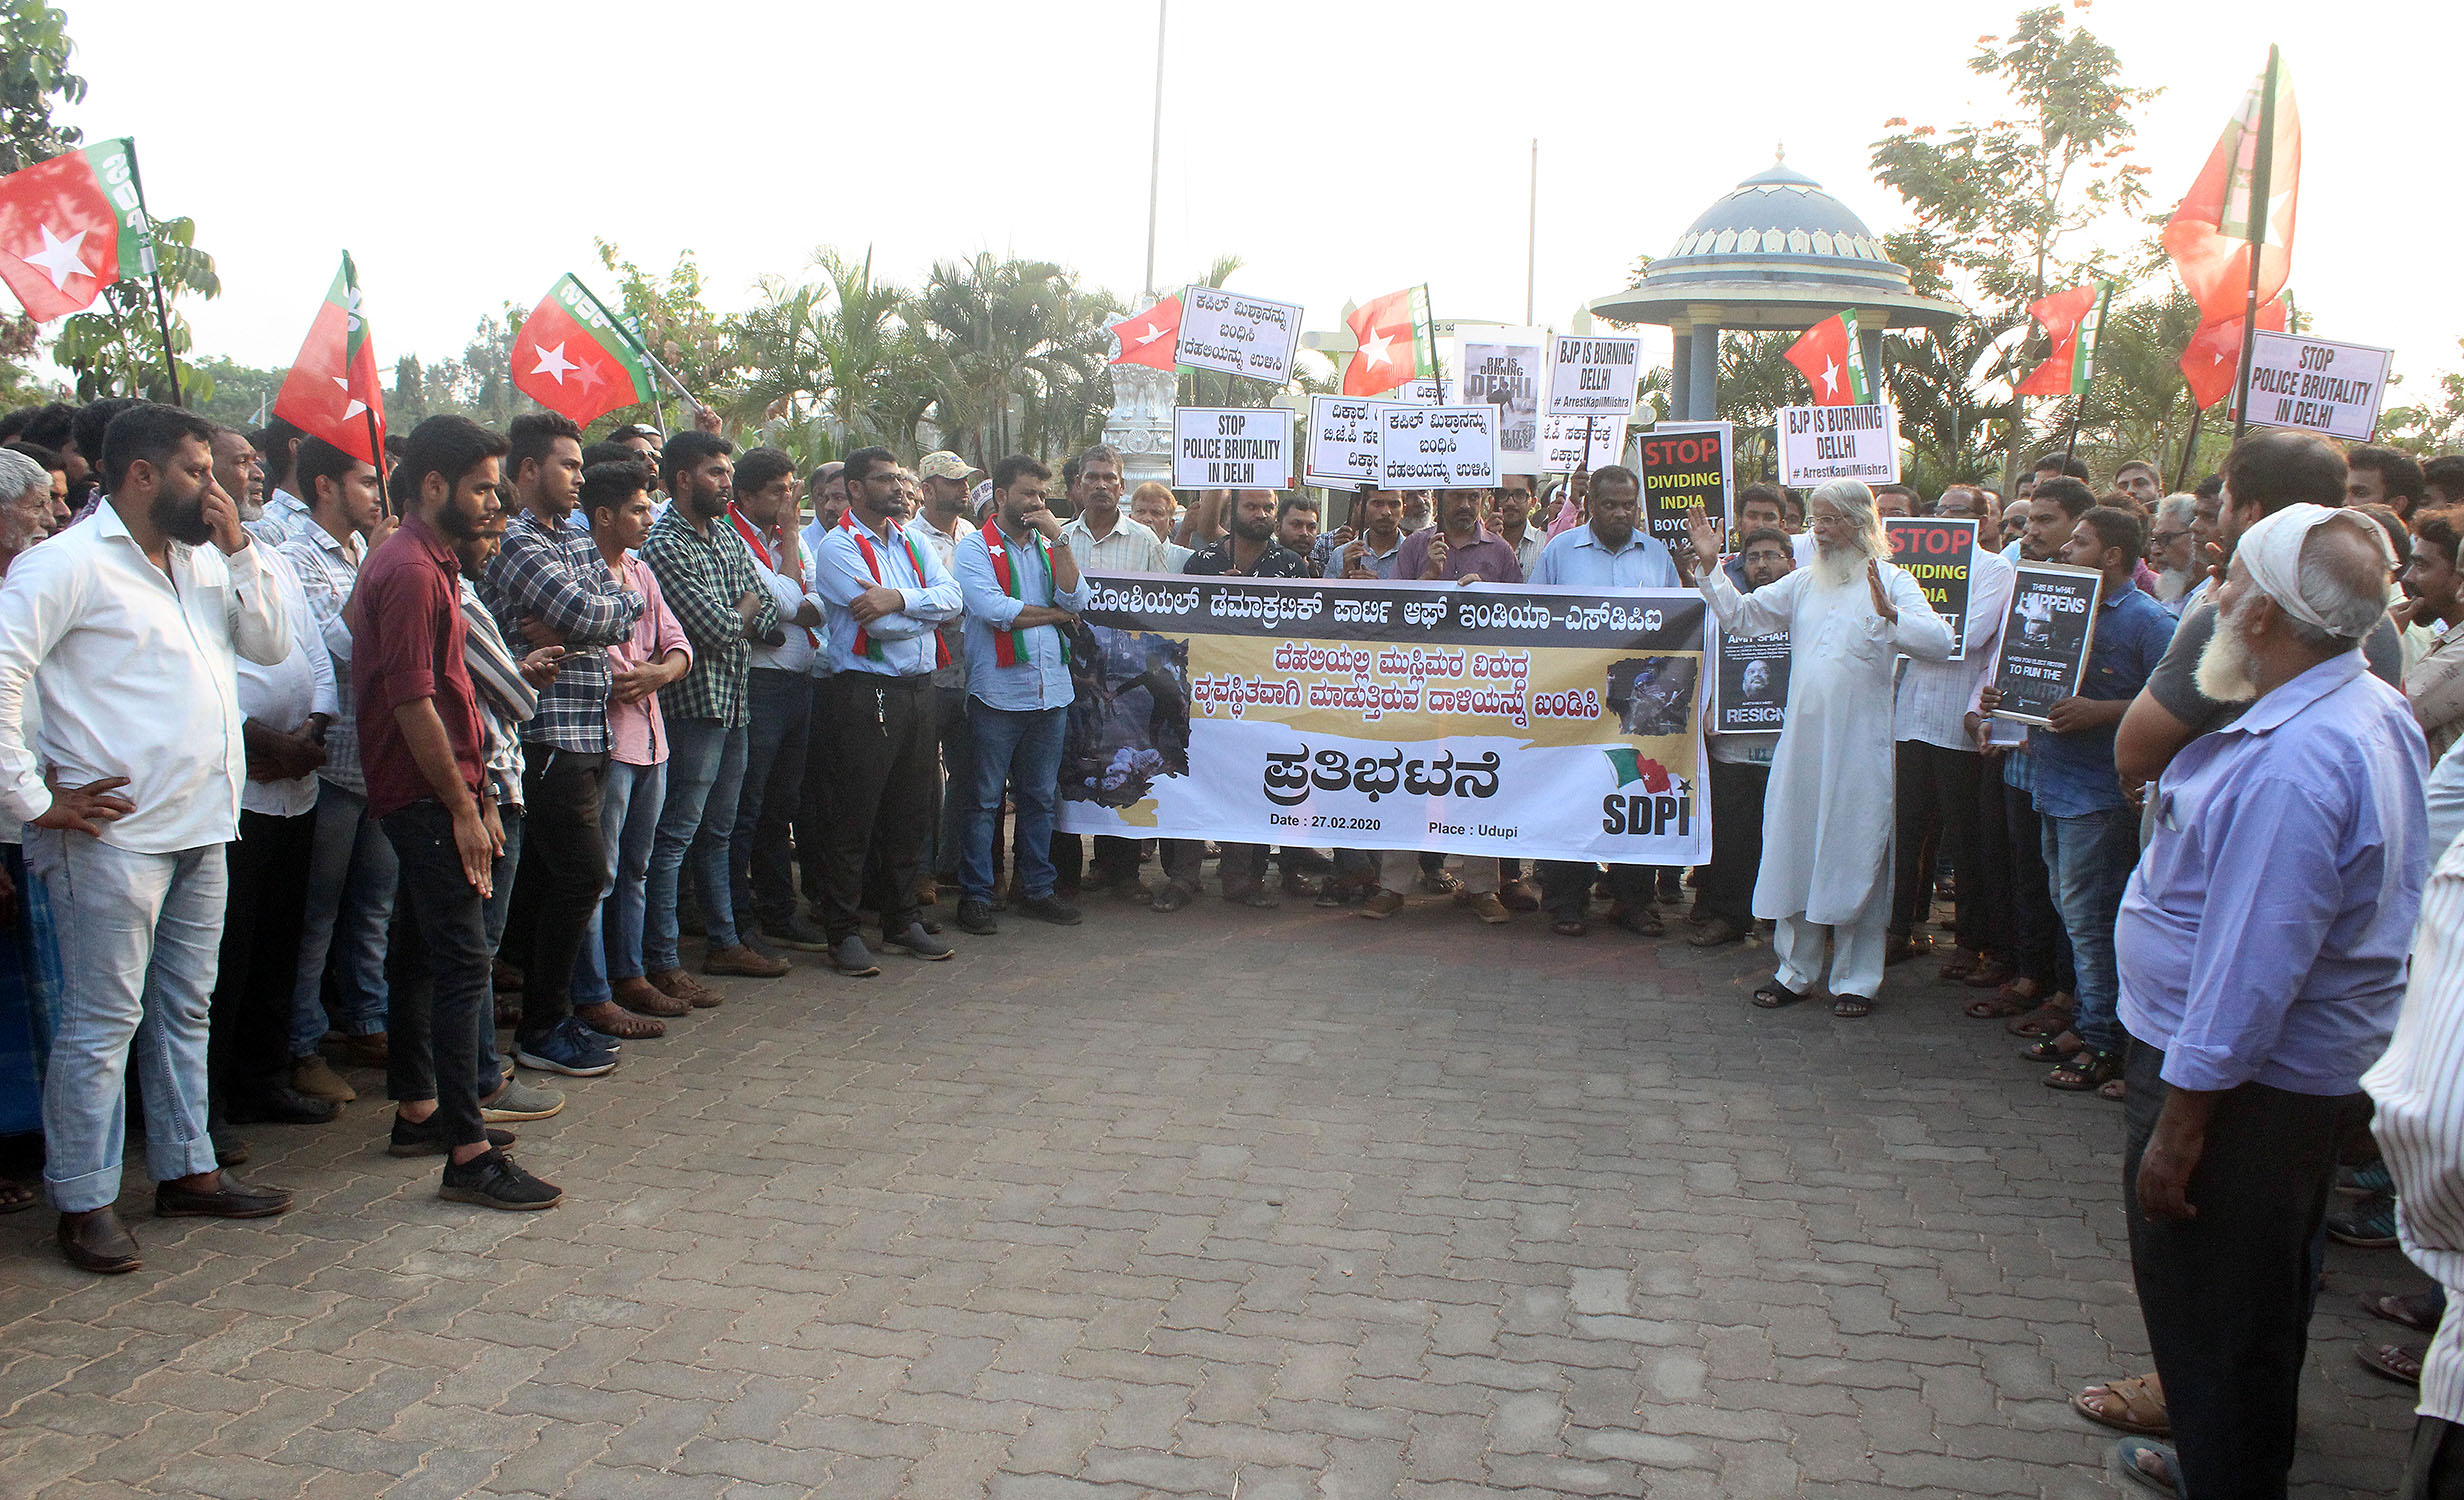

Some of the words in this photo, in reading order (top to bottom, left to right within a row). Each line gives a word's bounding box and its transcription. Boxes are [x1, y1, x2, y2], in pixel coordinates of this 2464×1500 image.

[1196, 294, 1230, 312] ಕಪಿಲ್
[1220, 323, 1255, 342] ಬಂಧಿಸಿ
[1184, 337, 1243, 371] ದೆಹಲಿಯನ್ನು
[1250, 353, 1282, 371] ಉಳಿಸಿ
[1487, 357, 1504, 367] BJP
[1508, 357, 1518, 367] IS
[1560, 341, 1580, 364] BJP
[1582, 342, 1592, 364] IS
[1594, 342, 1635, 365] BURNING
[2299, 346, 2335, 372] STOP
[1480, 366, 1524, 377] BURNING
[1580, 368, 1611, 390] DELLHI
[2251, 367, 2300, 396] POLICE
[2300, 373, 2372, 406] BRUTALITY
[1218, 415, 1246, 435] STOP
[1389, 411, 1424, 430] ಕಪಿಲ್
[1430, 412, 1487, 435] ಮಿಶ್ರಾನನ್ನು
[1790, 410, 1810, 434] BJP
[1814, 409, 1825, 433] IS
[1828, 405, 1883, 433] BURNING
[2274, 398, 2293, 423] IN
[2293, 401, 2334, 429] DELHI
[1183, 438, 1221, 459] POLICE
[1224, 439, 1280, 460] BRUTALITY
[1419, 438, 1457, 455] ಬಂಧಿಸಿ
[1645, 438, 1720, 466] STOP
[1816, 435, 1857, 460] DELLHI
[1208, 462, 1220, 483] IN
[1224, 463, 1254, 483] DELHI
[1387, 460, 1451, 484] ದೆಹಲಿಯನ್ನು
[1456, 462, 1491, 477] ಉಳಿಸಿ
[1647, 472, 1721, 489] DIVIDING
[1660, 494, 1705, 510] INDIA
[1654, 516, 1718, 532] BOYCT
[1888, 527, 1972, 554] STOP
[2055, 585, 2076, 595] WHAT
[1210, 587, 1323, 629] ಡೆಮಾಕ್ರಟಿಕ್
[1333, 598, 1392, 624] ಪಾರ್ಟಿ
[1403, 596, 1448, 631] ಆಫ್
[1274, 642, 1371, 685] ದೆಹಲಿಯಲ್ಲಿ
[1379, 647, 1464, 687] ಮುಸ್ಲಿಮರ
[2009, 664, 2022, 675] TO
[2022, 666, 2042, 678] RUN
[2043, 668, 2063, 681] THE
[1194, 674, 1301, 719] ವ್ಯವಸ್ಥಿತವಾಗಿ
[1310, 678, 1420, 720] ಮಾಡುತ್ತಿರುವ
[1428, 685, 1527, 727] ದಾಳಿಯನ್ನು
[1534, 690, 1600, 718] ಖಂಡಿಸಿ
[1263, 743, 1500, 807] ಪ್ರತಿಭಟನೆ
[1270, 813, 1300, 827] Date
[1311, 816, 1381, 831] 27.02.2020
[1603, 794, 1690, 836] SDPI
[1429, 822, 1466, 836] Place
[1478, 824, 1518, 839] Udupi
